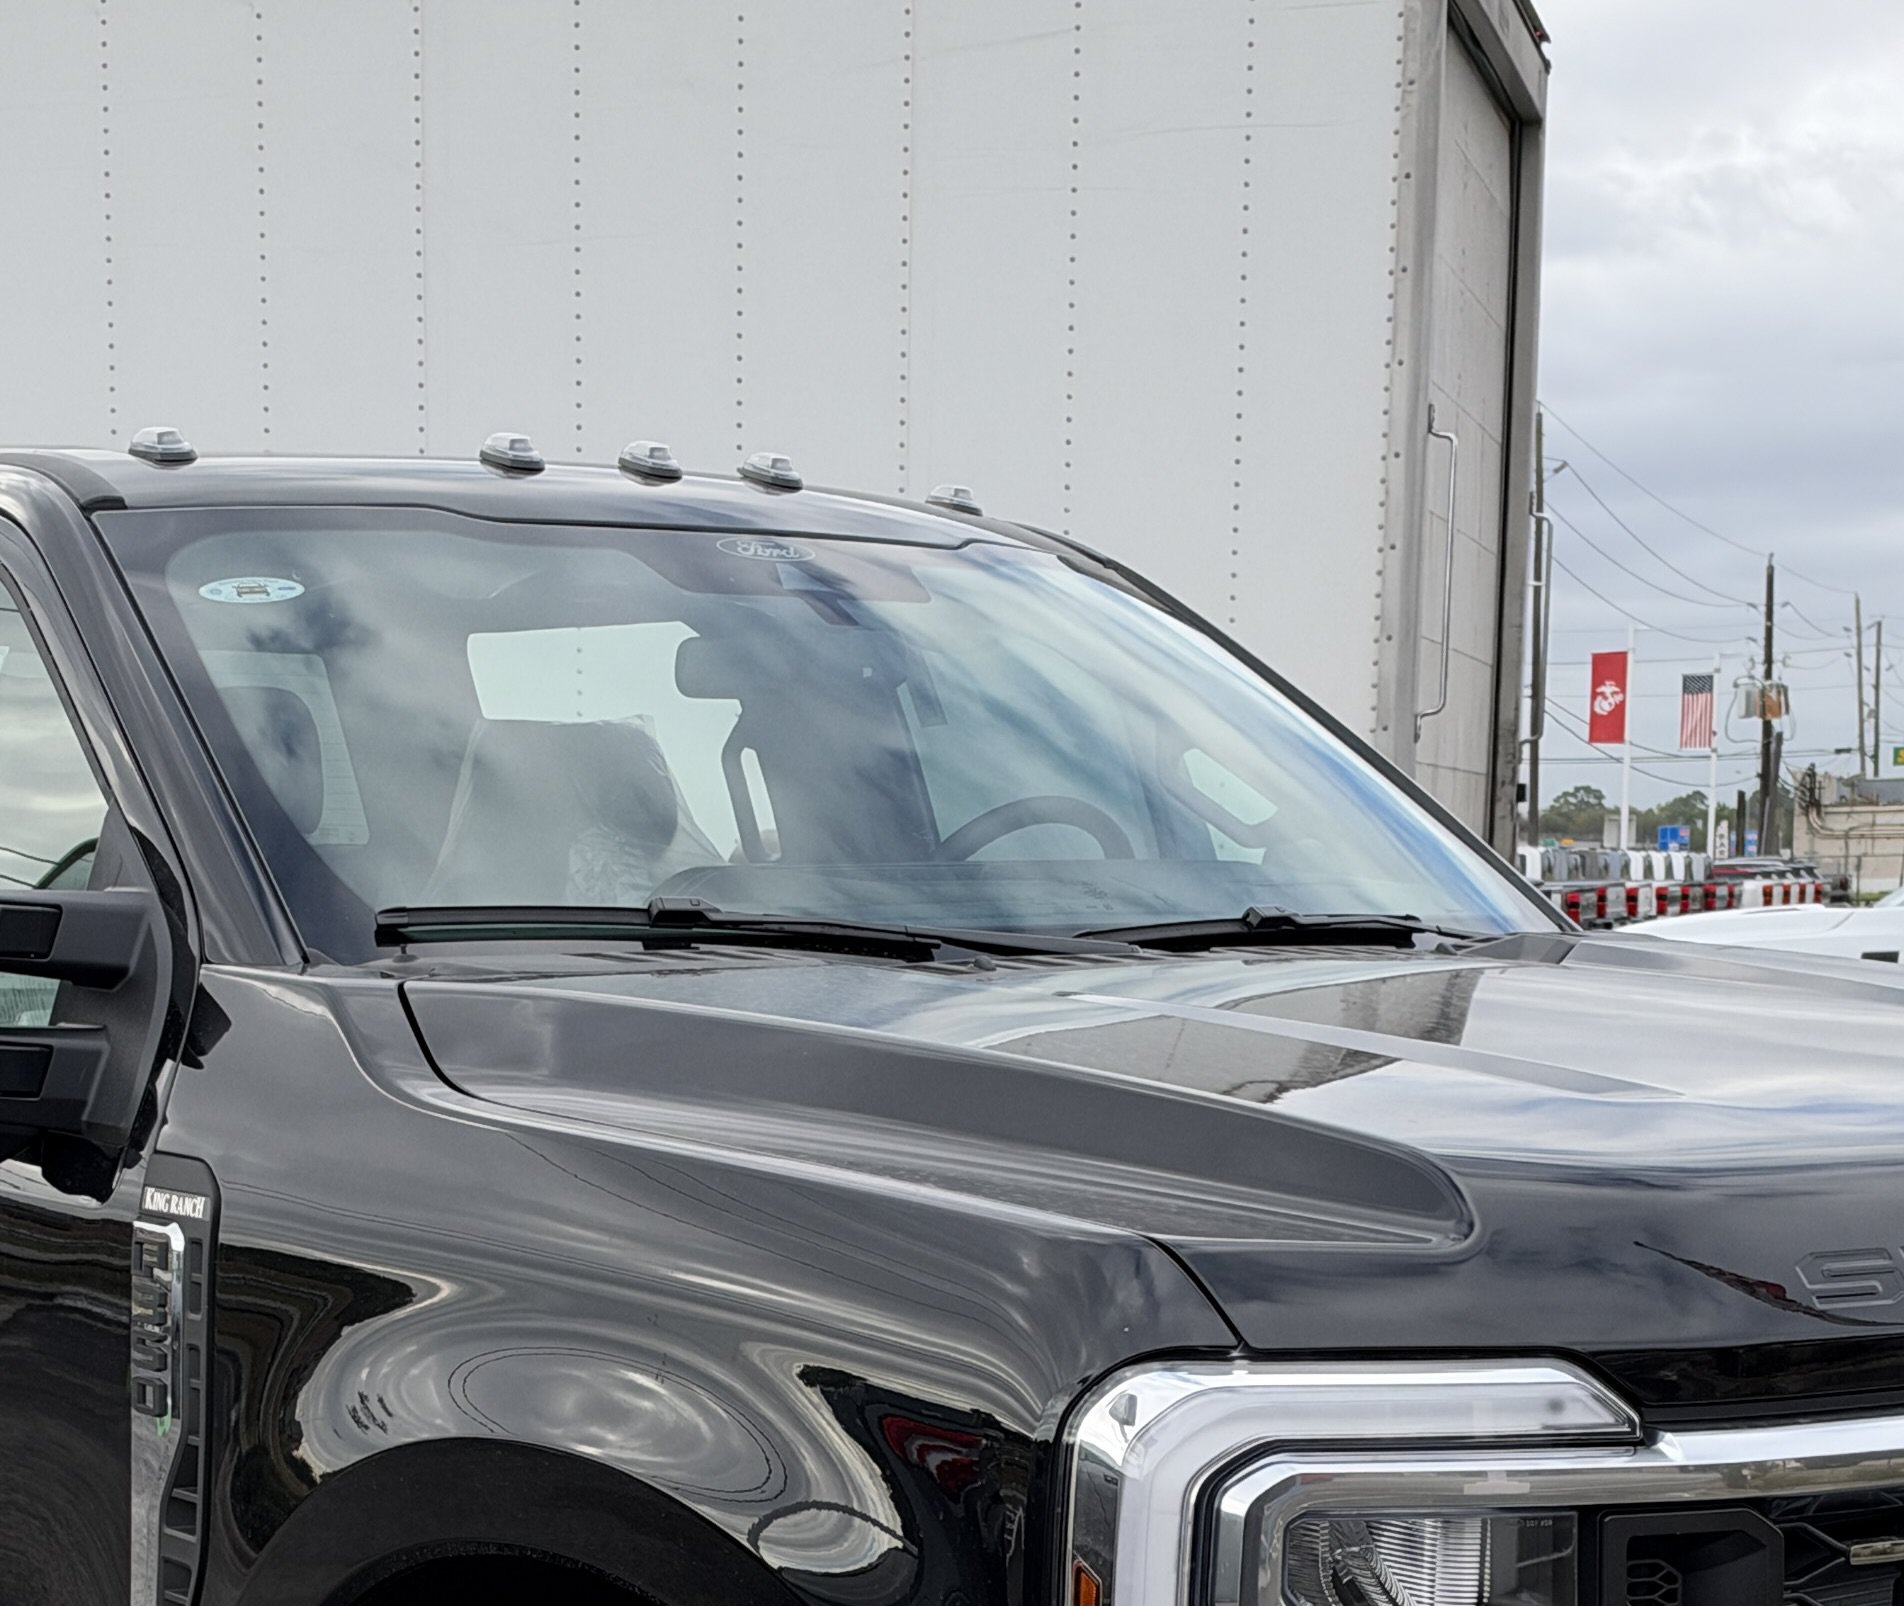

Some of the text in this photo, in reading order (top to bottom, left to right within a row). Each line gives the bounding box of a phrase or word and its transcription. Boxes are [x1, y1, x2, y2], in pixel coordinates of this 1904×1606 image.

[737, 541, 799, 558] Ford
[144, 1187, 206, 1220] KING RANCH
